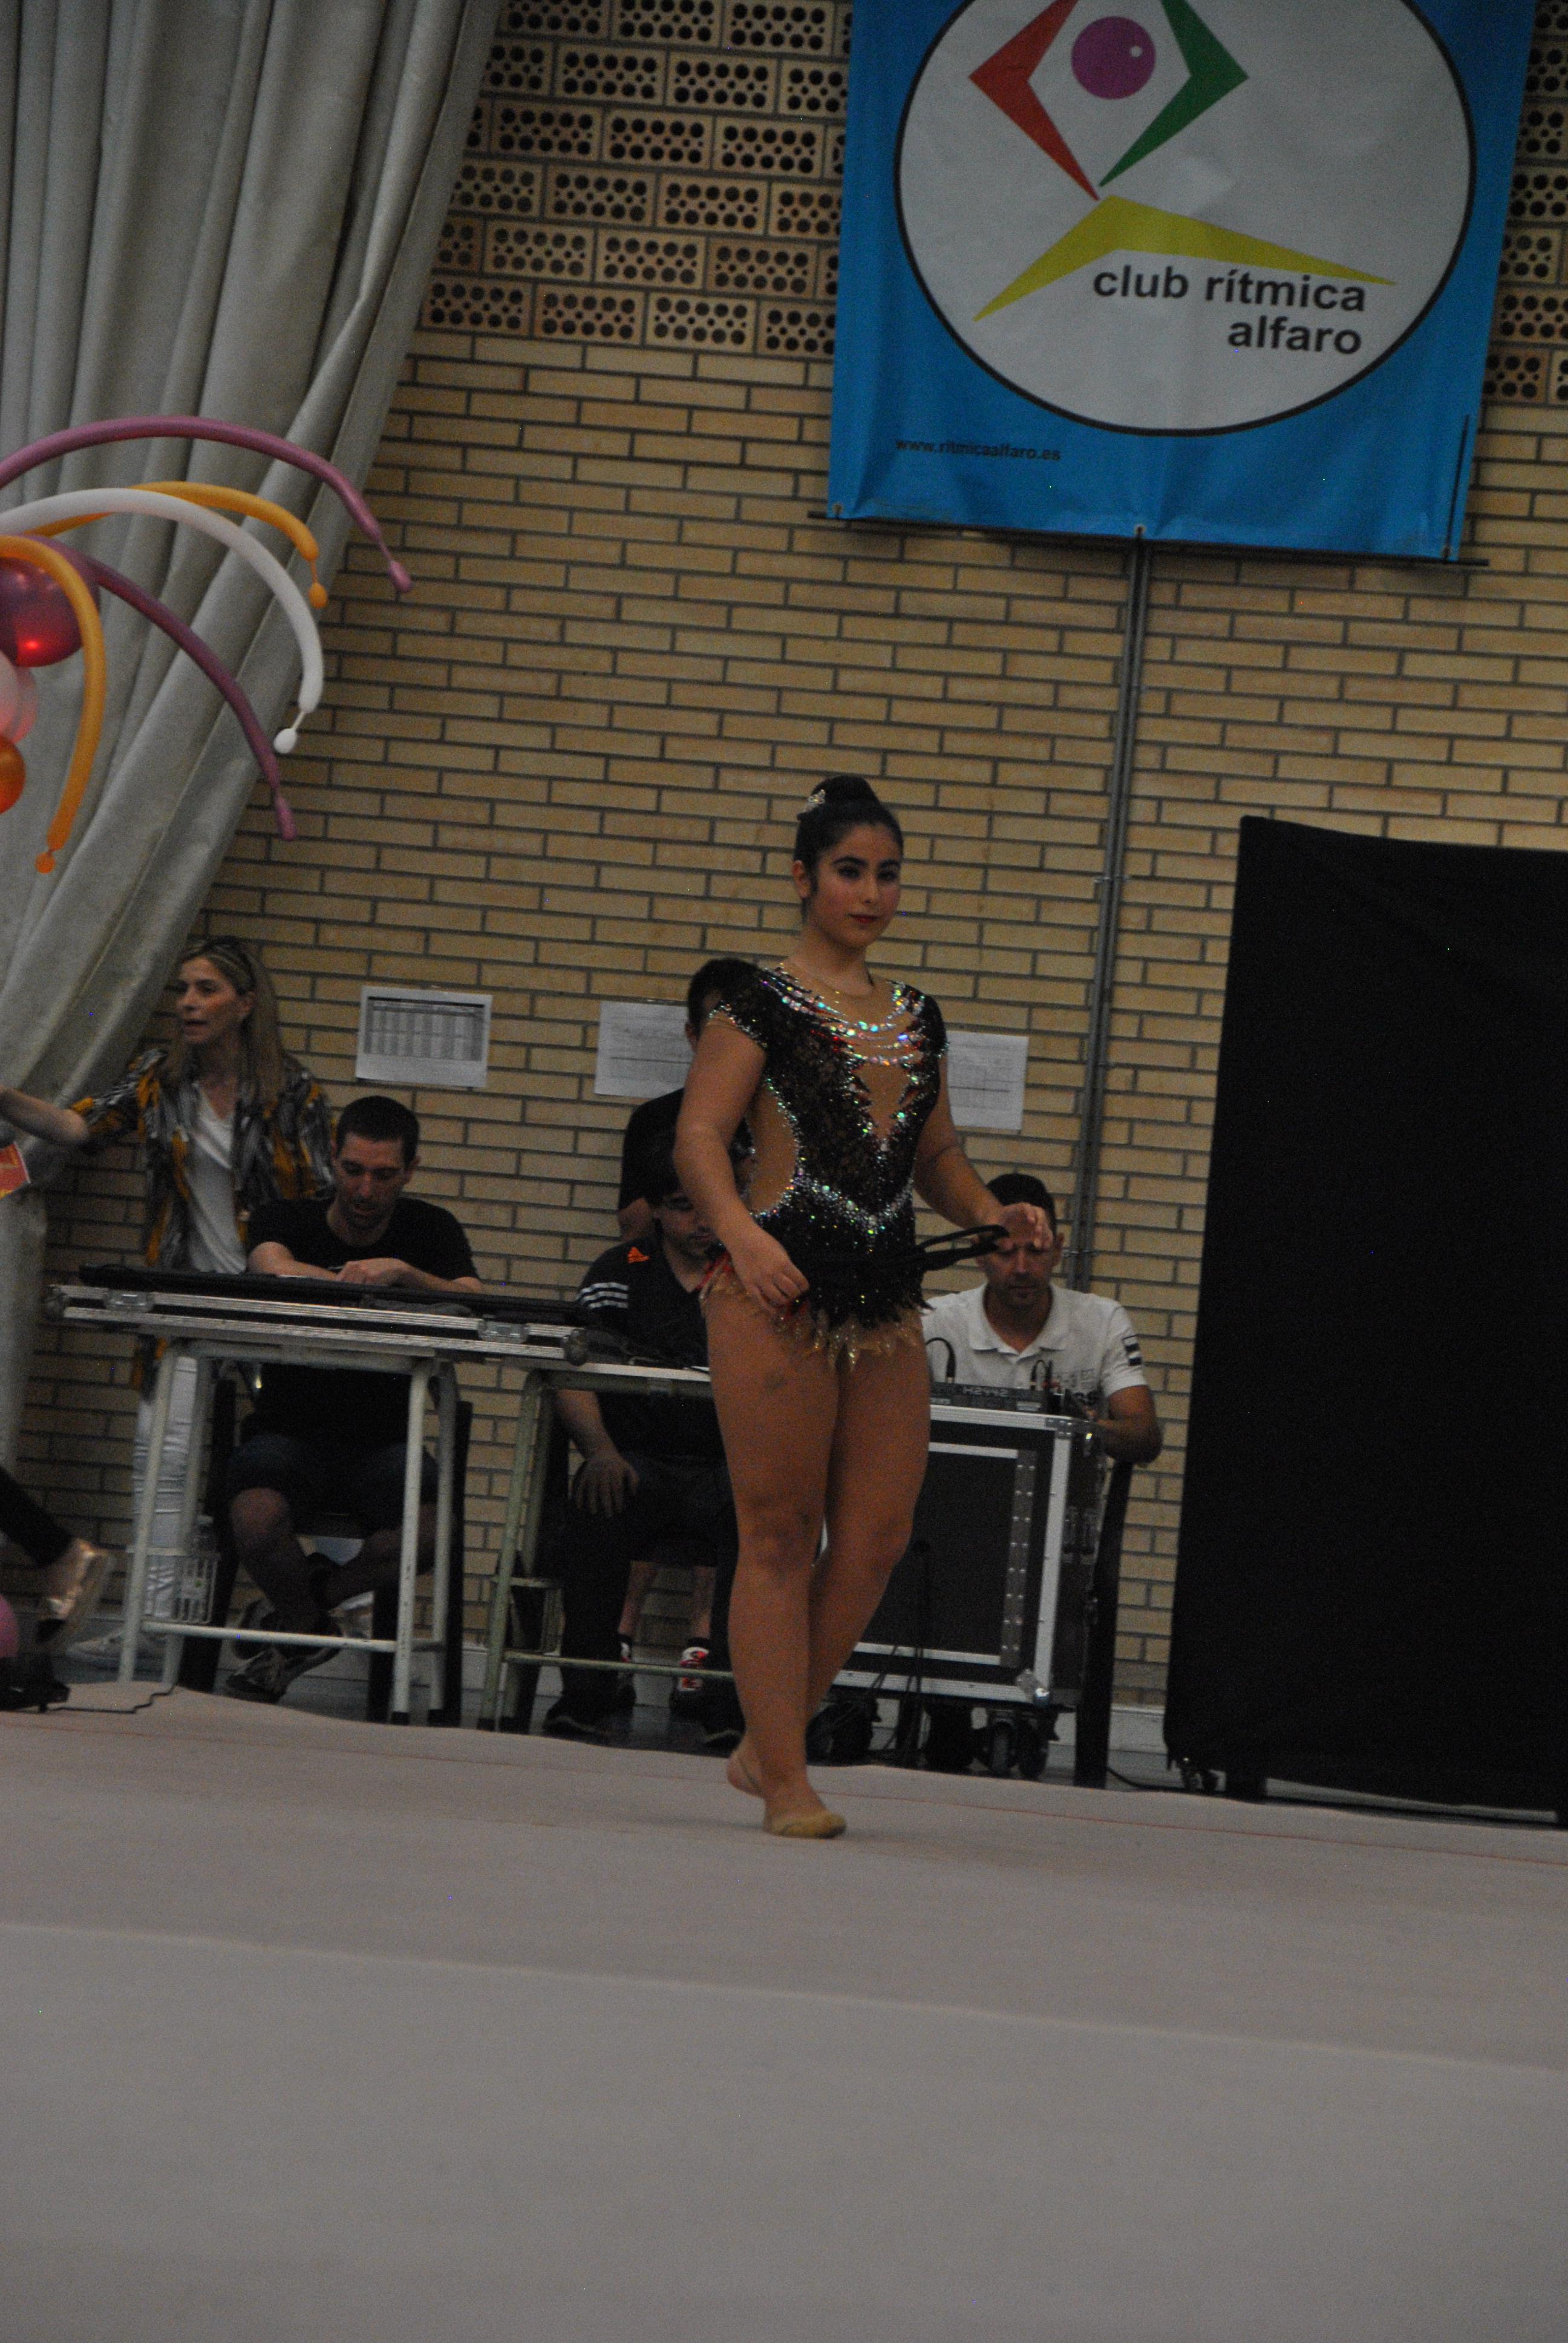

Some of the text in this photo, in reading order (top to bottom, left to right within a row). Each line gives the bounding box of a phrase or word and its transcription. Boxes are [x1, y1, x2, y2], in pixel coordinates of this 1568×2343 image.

[1093, 264, 1366, 312] club rítmica
[1227, 315, 1362, 355] alfaro
